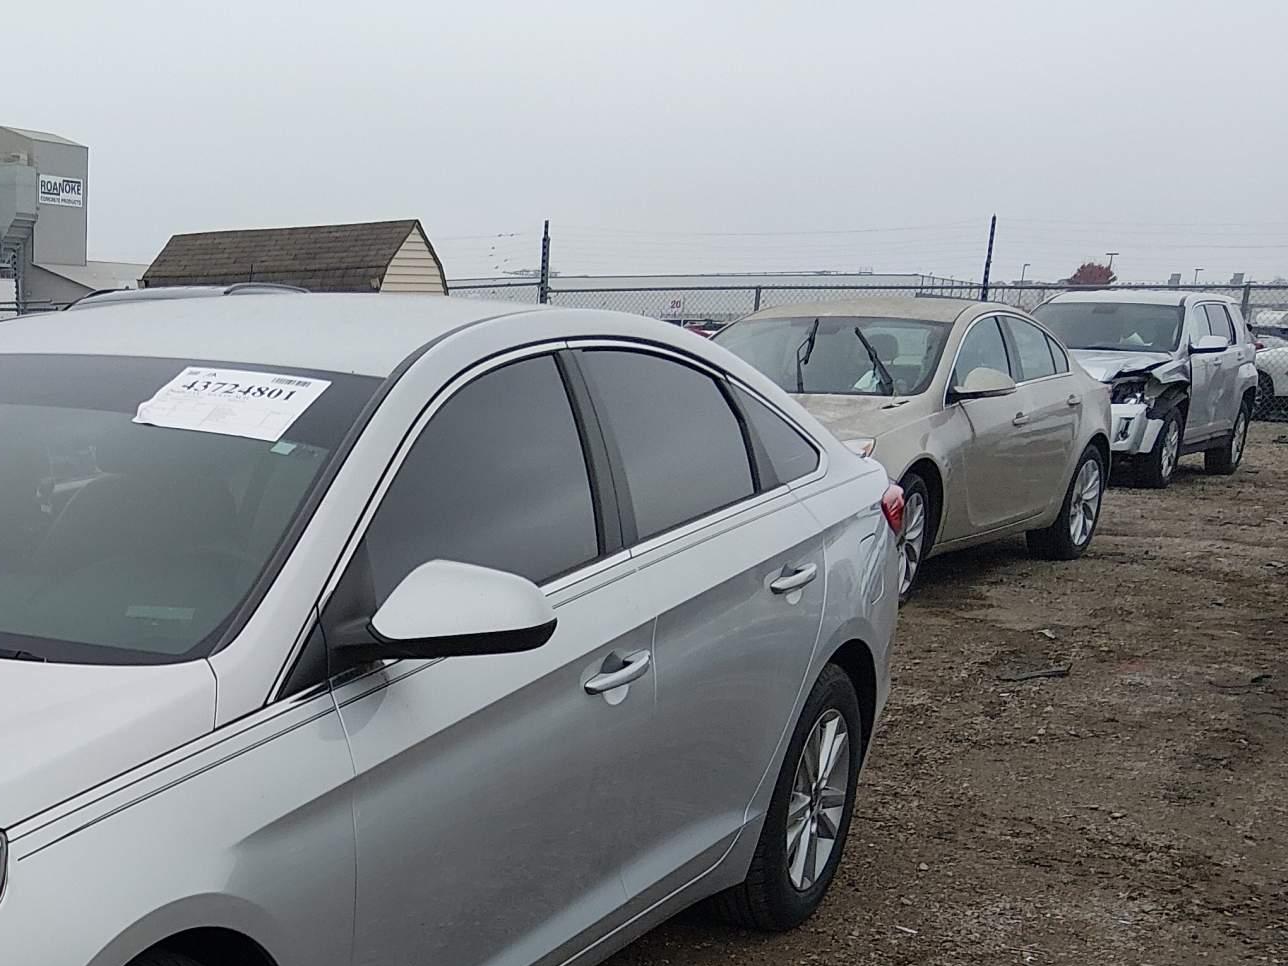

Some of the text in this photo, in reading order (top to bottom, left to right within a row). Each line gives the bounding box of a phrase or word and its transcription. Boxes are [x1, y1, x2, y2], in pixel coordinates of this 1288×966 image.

[40, 180, 81, 196] ROANOKE
[670, 300, 681, 309] 20
[182, 380, 296, 401] 43724801
